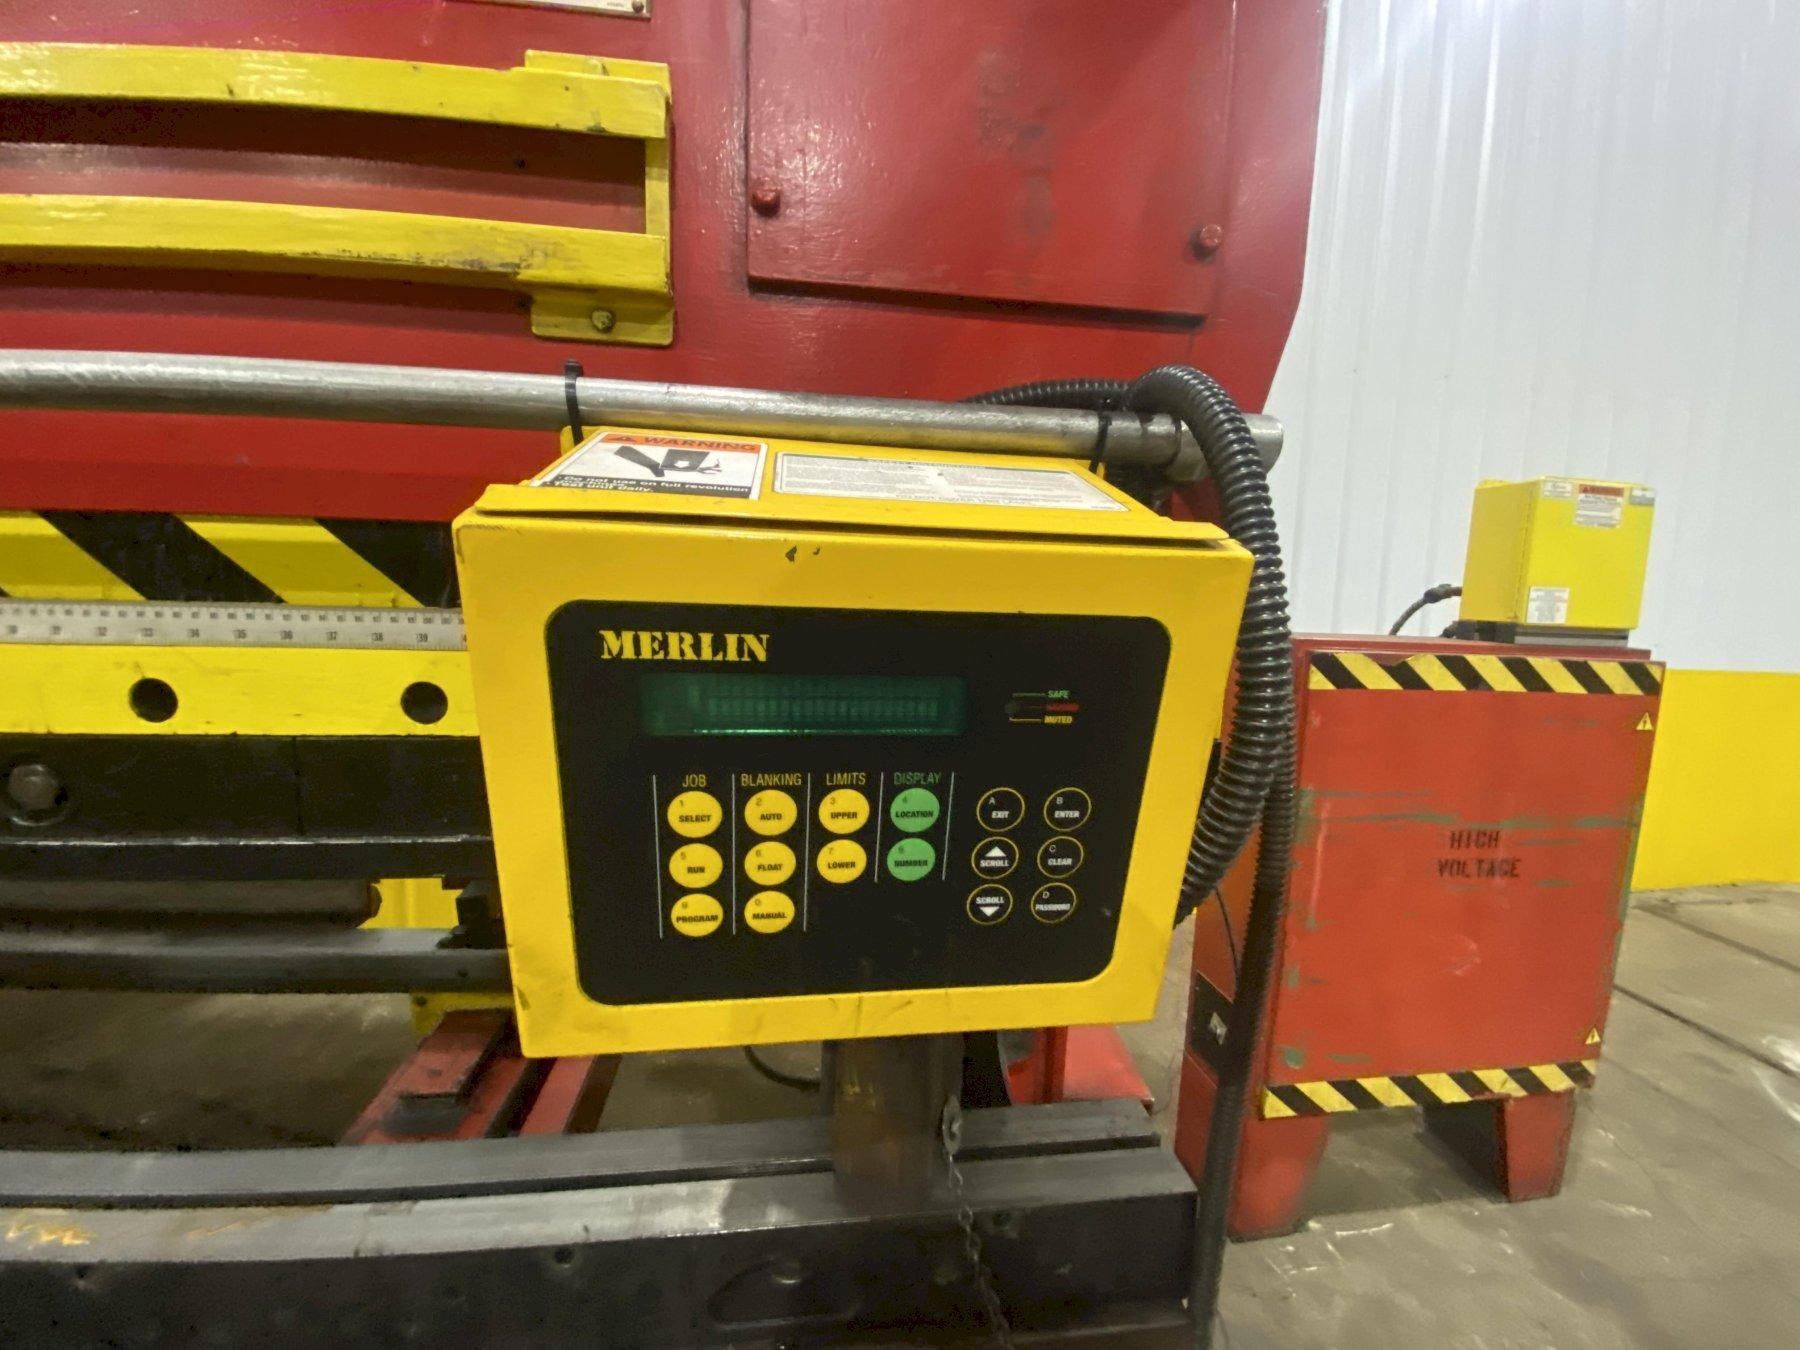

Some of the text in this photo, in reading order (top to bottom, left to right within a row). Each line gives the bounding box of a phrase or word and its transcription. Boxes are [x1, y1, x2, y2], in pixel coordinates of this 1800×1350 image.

[643, 435, 758, 451] WARNING
[554, 480, 583, 488] Test
[586, 482, 614, 490] unit
[618, 484, 654, 493] daily.
[587, 476, 608, 484] not
[660, 480, 682, 488] full
[685, 482, 749, 493] revolution
[599, 629, 770, 662] MERLIN
[682, 773, 708, 788] JOB
[740, 773, 802, 787] BLANKING
[826, 772, 866, 786] LIMITS
[893, 772, 941, 786] DISPLAY
[755, 798, 762, 806] 2
[830, 797, 837, 805] 3
[988, 796, 996, 805] A
[1056, 796, 1064, 805] B
[678, 814, 712, 823] SELECT
[759, 813, 783, 821] AUTO
[830, 811, 858, 820] UPPER
[895, 810, 934, 819] LOCATION
[991, 810, 1010, 819] EXIT
[1054, 810, 1080, 819] ENTER
[1450, 830, 1500, 850] HIGH
[1048, 844, 1057, 853] C
[827, 861, 856, 870] LOWER
[894, 859, 928, 868] NUMBER
[980, 859, 1010, 868] SCROLL
[1047, 857, 1073, 866] CLEAR
[687, 865, 706, 874] RUN
[757, 863, 784, 872] FLOAT
[1438, 858, 1521, 878] VOLTAGE
[975, 896, 1005, 905] SCROLL
[676, 914, 719, 924] PROGRAM
[752, 911, 788, 921] MANUAL
